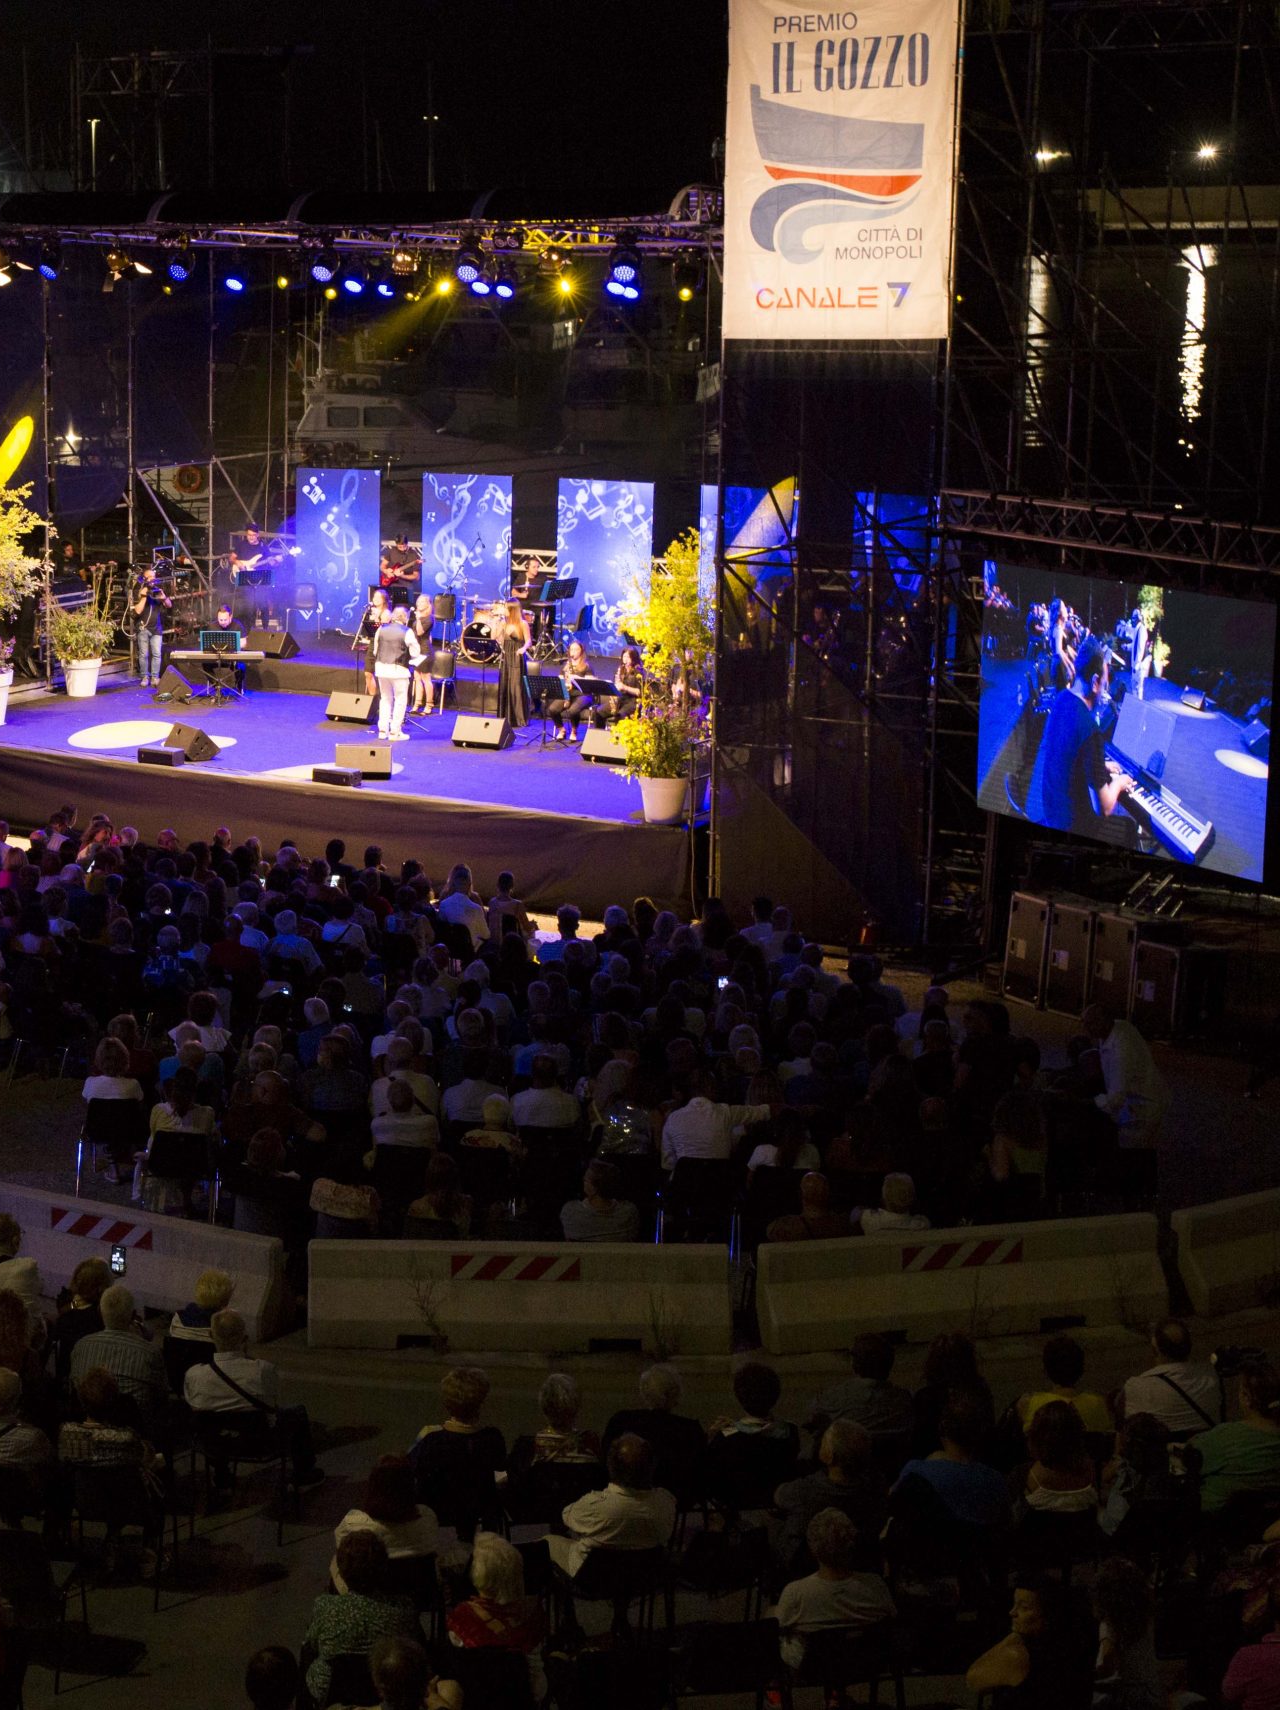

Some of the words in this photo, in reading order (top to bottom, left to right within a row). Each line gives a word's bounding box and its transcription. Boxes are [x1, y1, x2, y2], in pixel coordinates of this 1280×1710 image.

[773, 12, 858, 34] PREMIO
[770, 41, 802, 94] IL
[813, 32, 930, 92] GOZZO
[857, 224, 900, 243] CITTÀ
[906, 228, 923, 242] DI
[835, 245, 923, 261] MONOPOLI
[755, 287, 879, 309] CANALE
[886, 282, 911, 308] 7
